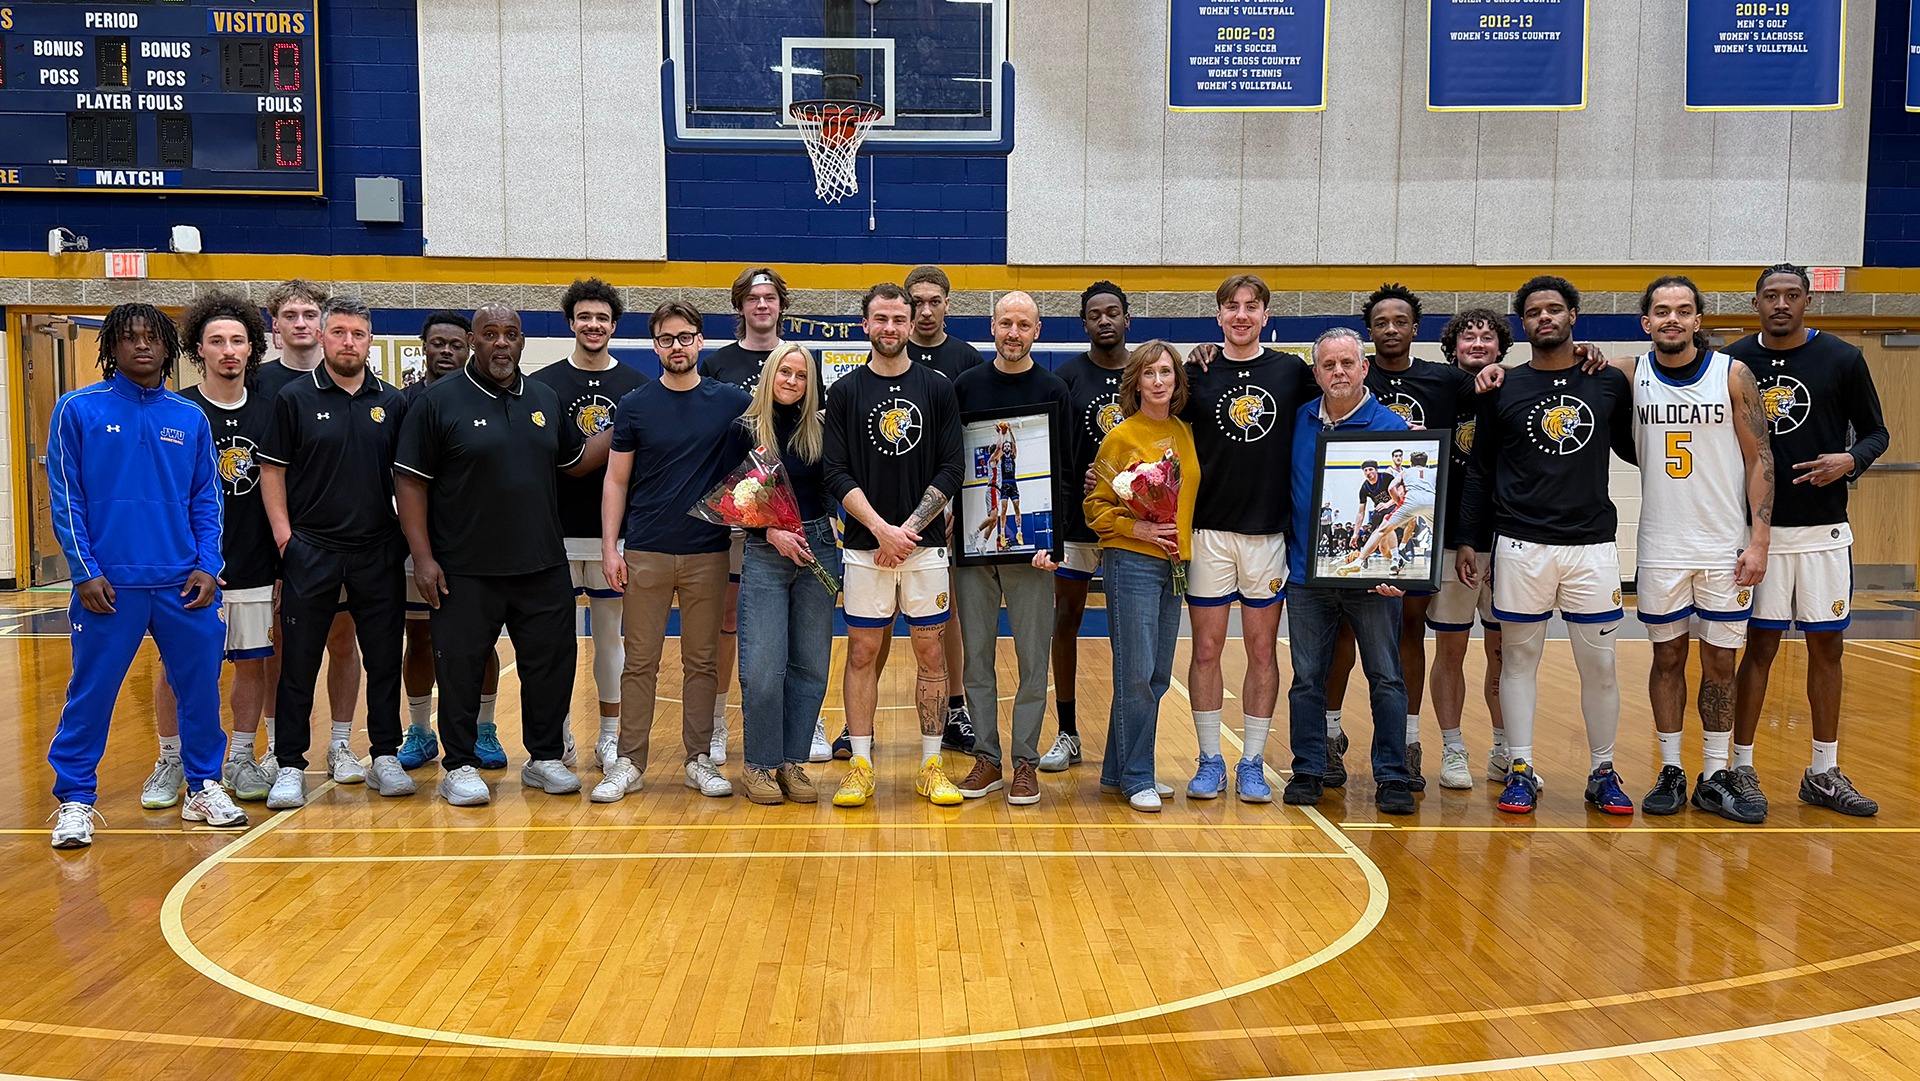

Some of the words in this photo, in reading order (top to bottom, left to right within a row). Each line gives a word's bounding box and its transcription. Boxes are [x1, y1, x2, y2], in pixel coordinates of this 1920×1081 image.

[1199, 6, 1239, 15] WOMEN'S
[1242, 6, 1294, 15] VOLLEYBALL
[1736, 3, 1790, 16] 2018-19
[85, 12, 138, 28] PERIOD
[213, 12, 305, 33] VISITORS
[1479, 15, 1533, 28] 2012-13
[1736, 19, 1764, 28] MEN'S
[1766, 20, 1787, 28] GOLF
[1217, 27, 1275, 40] 2002-03
[1450, 31, 1490, 40] WOMEN'S
[1492, 32, 1519, 40] CROSS
[1522, 31, 1561, 40] COUNTRY
[1719, 32, 1759, 41] WOMEN'S
[1761, 32, 1804, 40] LACROSSE
[33, 40, 84, 57] BONUS
[141, 41, 191, 58] BONUS
[1214, 44, 1242, 53] MEN'S
[1244, 44, 1277, 53] SOCCER
[1714, 44, 1754, 53] WOMEN'S
[1756, 44, 1808, 53] VOLLEYBALL
[120, 42, 128, 86] 1
[273, 43, 300, 91] 0
[1189, 56, 1230, 65] WOMEN'S
[1231, 56, 1259, 65] CROSS
[1261, 56, 1301, 65] COUNTRY
[40, 69, 79, 85] POSS
[147, 70, 186, 86] POSS
[1208, 69, 1248, 77] WOMEN'S
[1250, 69, 1282, 77] TENNIS
[1197, 81, 1237, 90] WOMEN'S
[1239, 81, 1292, 90] VOLLEYBALL
[76, 93, 132, 110] PLAYER
[138, 94, 184, 110] FOULS
[257, 96, 302, 112] FOULS
[275, 119, 302, 166] 0
[95, 170, 164, 185] MATCH
[112, 254, 140, 277] EXIT
[1637, 403, 1725, 424] WILDCATS
[160, 427, 185, 441] JWU
[1664, 431, 1693, 479] 5
